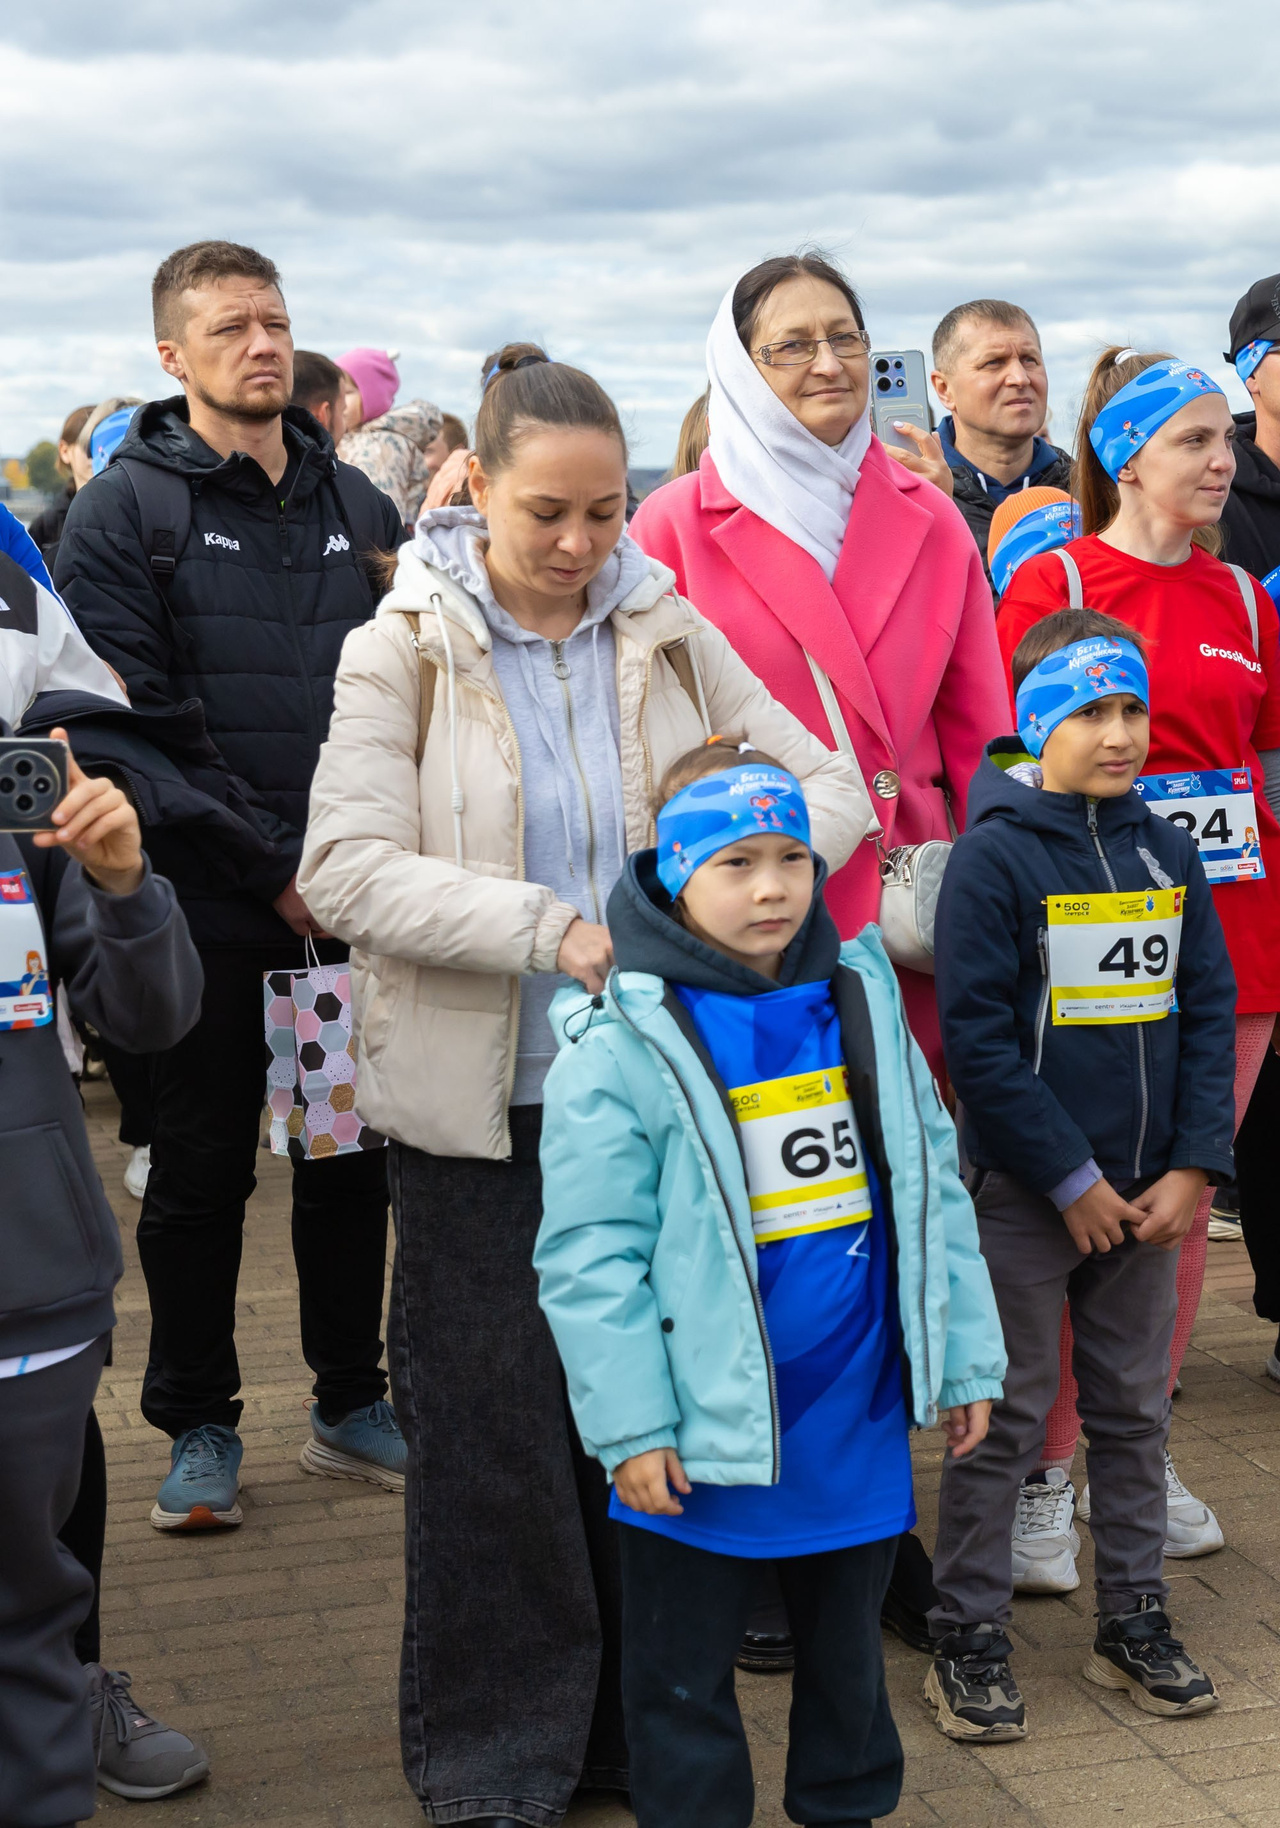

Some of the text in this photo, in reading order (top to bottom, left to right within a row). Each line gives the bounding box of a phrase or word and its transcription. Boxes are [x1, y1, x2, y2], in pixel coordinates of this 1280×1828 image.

[203, 532, 241, 551] Kappa
[1064, 902, 1090, 911] 500
[1098, 934, 1169, 978] 49
[781, 1119, 858, 1178] 65
